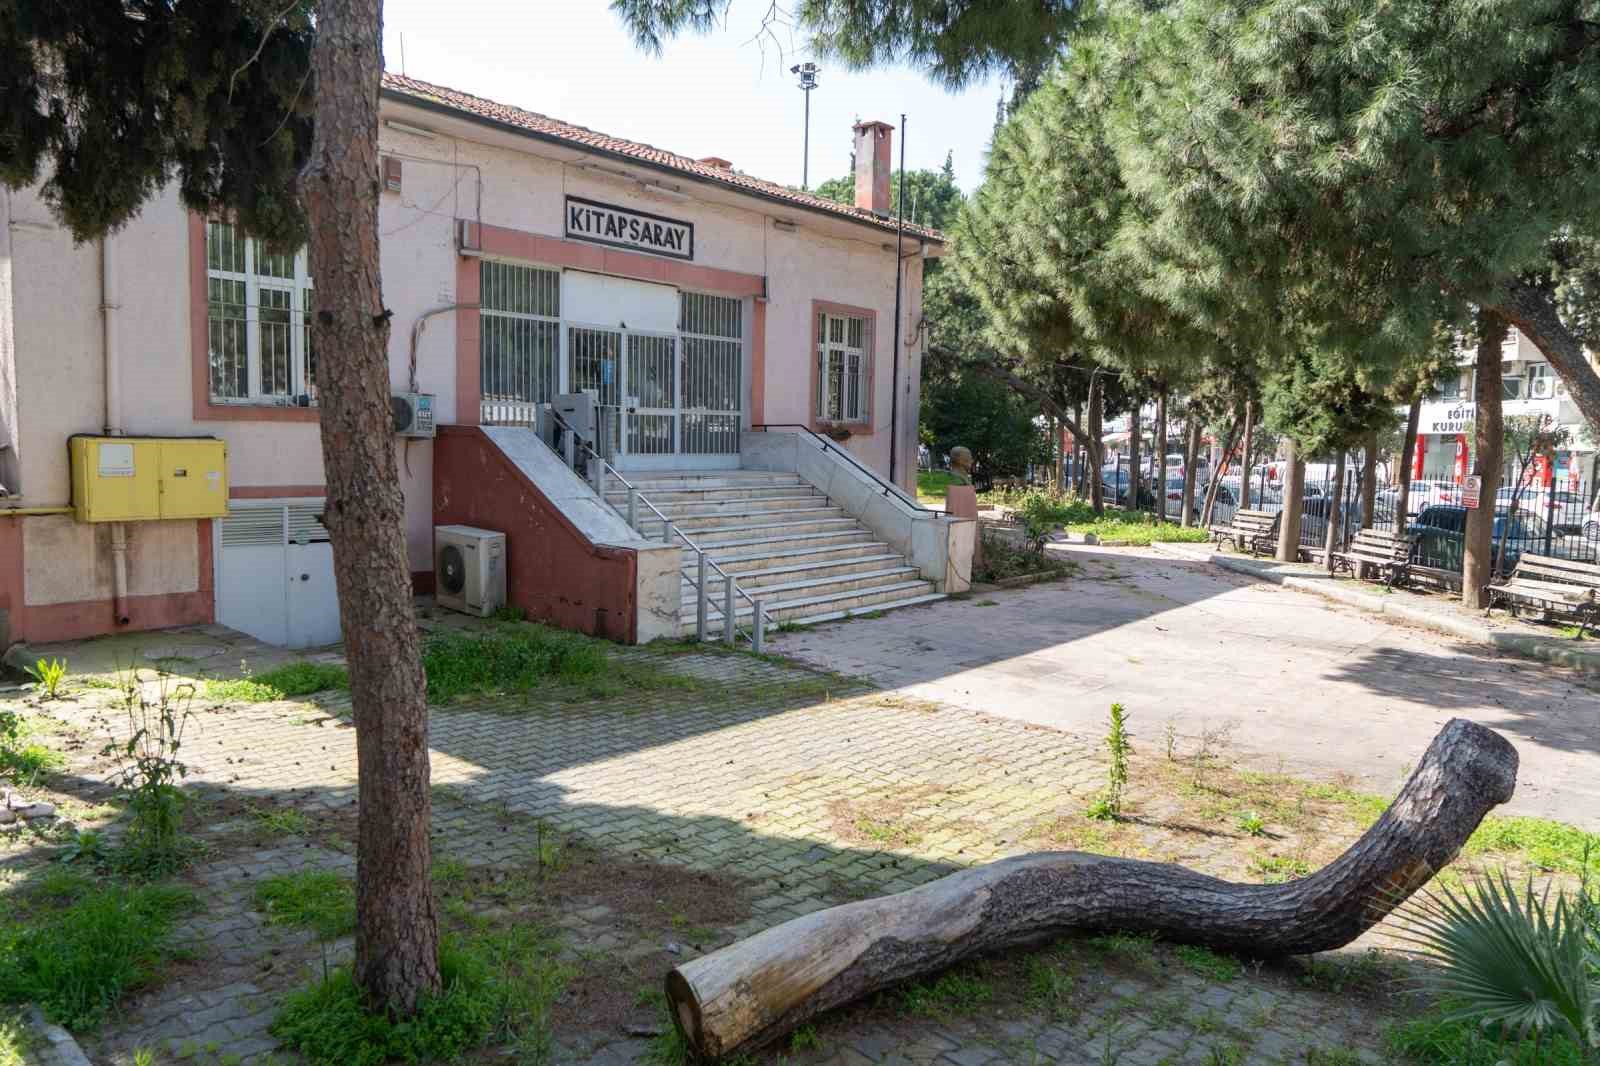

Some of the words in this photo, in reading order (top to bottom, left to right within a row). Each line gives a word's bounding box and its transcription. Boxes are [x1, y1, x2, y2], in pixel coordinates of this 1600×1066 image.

[570, 206, 686, 250] KİTAPSARAY
[1447, 407, 1475, 420] EĞİTİ
[1432, 422, 1472, 432] KURU
